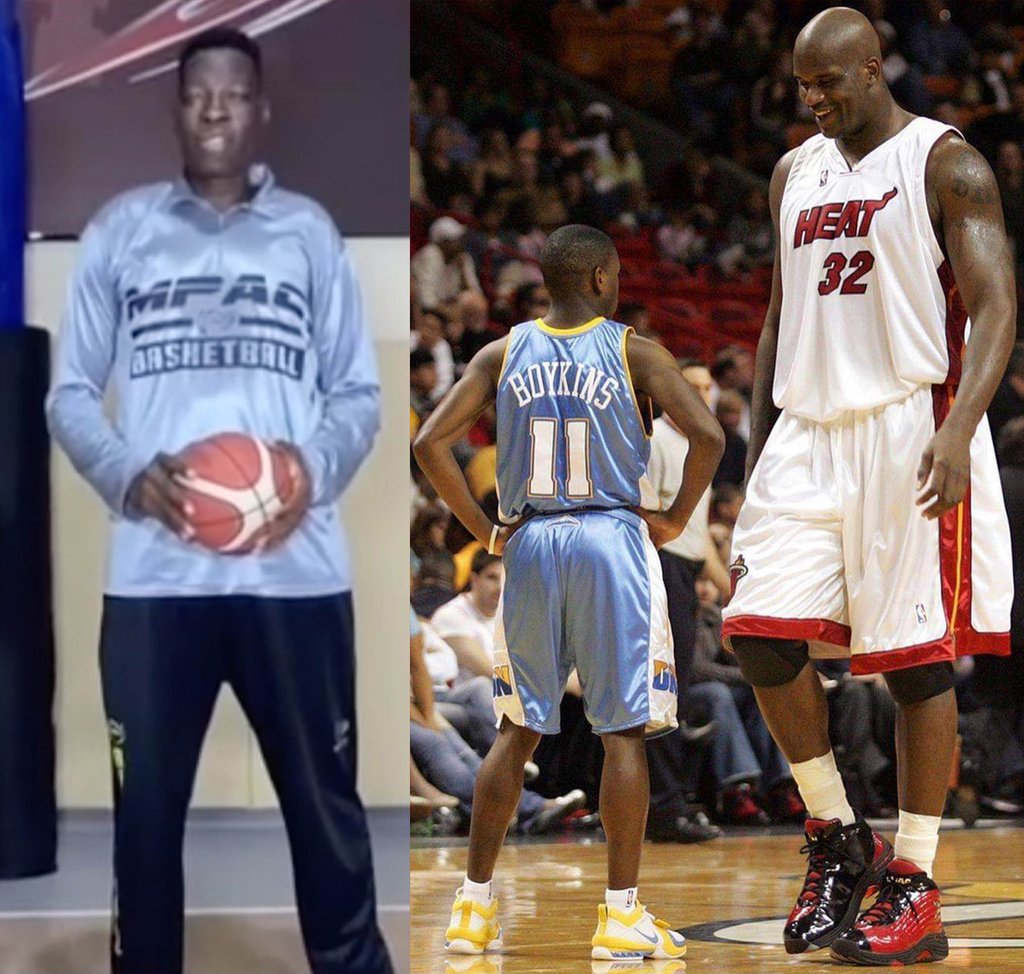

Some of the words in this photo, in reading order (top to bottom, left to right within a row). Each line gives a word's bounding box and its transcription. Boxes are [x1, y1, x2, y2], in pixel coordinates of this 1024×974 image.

[793, 186, 898, 249] HEAT
[817, 250, 875, 296] 32
[132, 339, 302, 379] BASKETBALL
[507, 361, 621, 410] BOYKINS
[527, 416, 594, 499] 11
